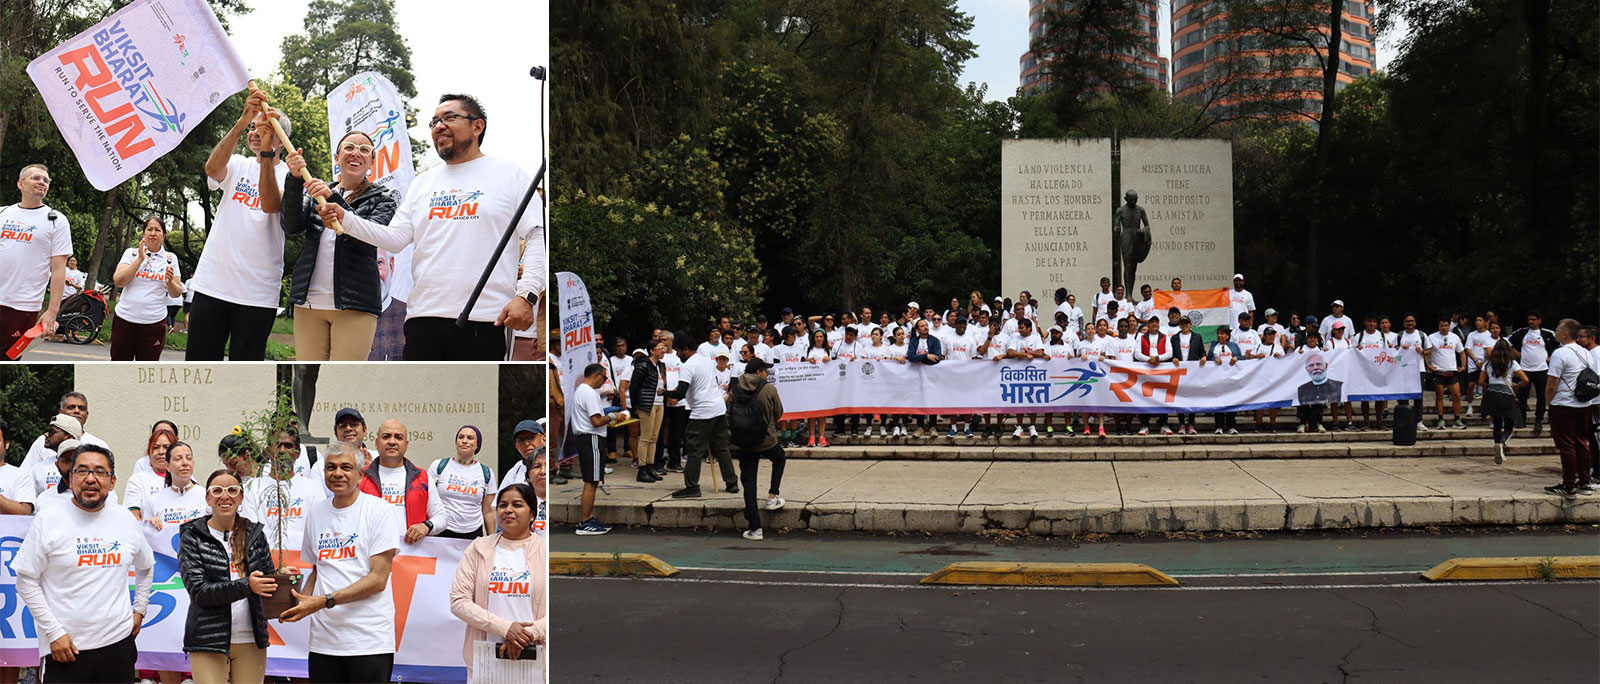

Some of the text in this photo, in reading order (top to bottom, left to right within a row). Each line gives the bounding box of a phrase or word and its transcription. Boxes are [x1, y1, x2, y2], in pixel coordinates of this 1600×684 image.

[109, 19, 154, 82] VIKSIT
[93, 28, 150, 109] BHARAT
[58, 44, 156, 160] RUN
[55, 66, 122, 171] RUN TO SERVE THE NATION
[1018, 164, 1093, 174] LA NO VIOLENCIA
[1142, 164, 1211, 174] NUESTRA LUCHA
[1030, 180, 1083, 189] HA LLEGADO
[1166, 180, 1190, 189] TIENE
[429, 199, 462, 207] BHARAT
[1012, 195, 1103, 205] HASTA LOS HOMBRES
[1145, 195, 1210, 205] POR PROPOSITO
[428, 202, 479, 220] RUN
[1022, 211, 1094, 220] Y PERMANECERA.
[1151, 211, 1204, 220] LA AMISTAD
[0, 230, 33, 241] RUN
[1034, 226, 1079, 236] ELLA ES LA
[1169, 226, 1186, 235] CON
[1025, 241, 1088, 252] ANUNCIADORA
[1152, 241, 1216, 251] MUNDO ENTERO
[1036, 257, 1077, 267] DE LA PAZ
[136, 270, 164, 281] RUN
[1049, 273, 1064, 283] DEL
[563, 313, 578, 326] VIKSIT
[564, 325, 592, 351] RUN
[138, 367, 213, 384] DE LA PAZ
[1000, 366, 1047, 381] विकसित
[1110, 366, 1187, 403] रन
[1000, 383, 1051, 404] भारत
[163, 396, 189, 412] DEL
[313, 402, 486, 414] OHANDAS KARAMCHAND GANDHI
[409, 431, 433, 442] 1948
[446, 483, 478, 495] RUN
[267, 507, 302, 517] RUN
[318, 542, 344, 550] BHARAT
[318, 545, 356, 561] RUN
[77, 553, 121, 567] RUN
[488, 582, 530, 594] RUN
